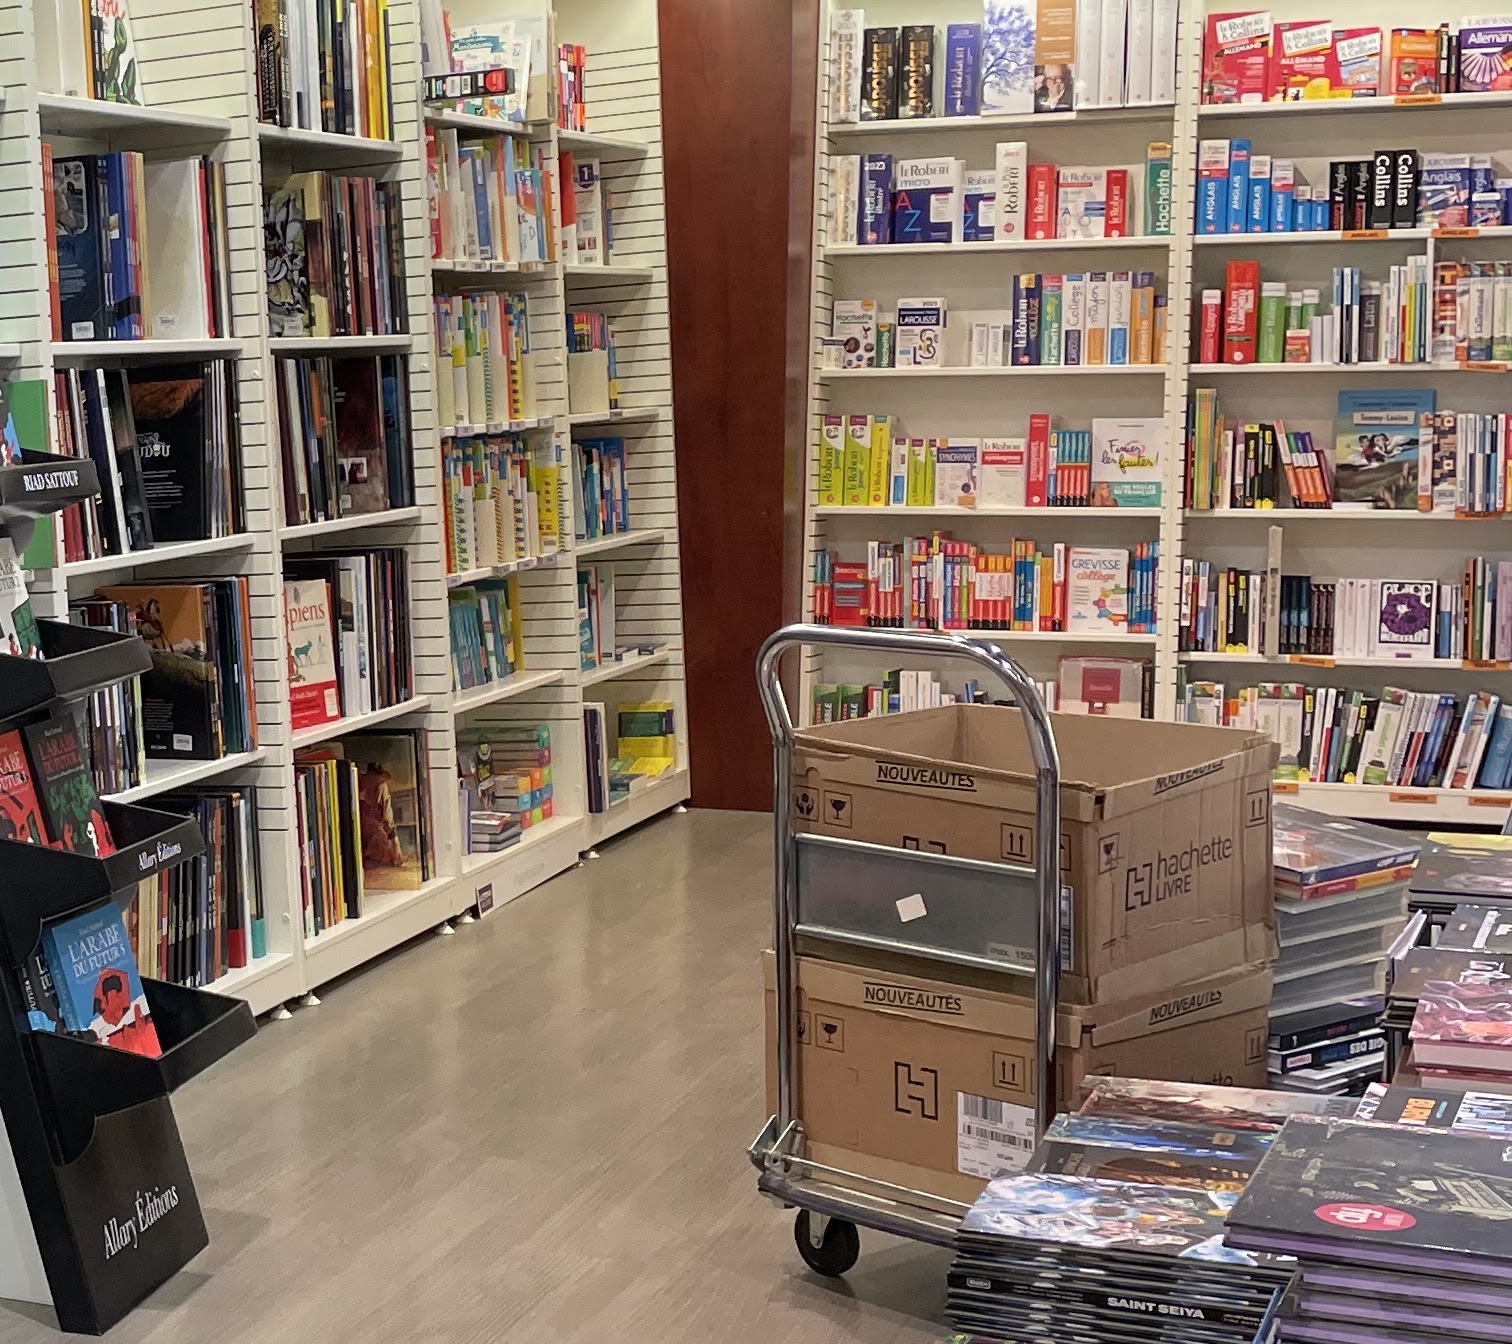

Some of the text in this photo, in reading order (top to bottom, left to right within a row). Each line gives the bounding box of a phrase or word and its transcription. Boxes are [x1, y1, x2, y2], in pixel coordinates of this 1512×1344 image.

[909, 164, 949, 177] Robert
[1374, 154, 1390, 207] Collins
[1397, 153, 1414, 206] Collins
[1155, 168, 1172, 232] Hachette
[899, 315, 938, 326] LAROUSSE
[23, 470, 79, 491] RIAD SATTOUF
[1072, 558, 1121, 571] GREVISSE
[1157, 835, 1233, 881] hachette
[1155, 874, 1192, 903] LIVRE
[68, 923, 121, 962] L'ARABE
[73, 948, 119, 978] DU FUTUR
[864, 985, 963, 1012] NOUVEAUTÉS
[103, 1185, 179, 1260] Allary Éditions
[1107, 1296, 1156, 1312] SAINT
[1157, 1304, 1205, 1320] SEIYA
